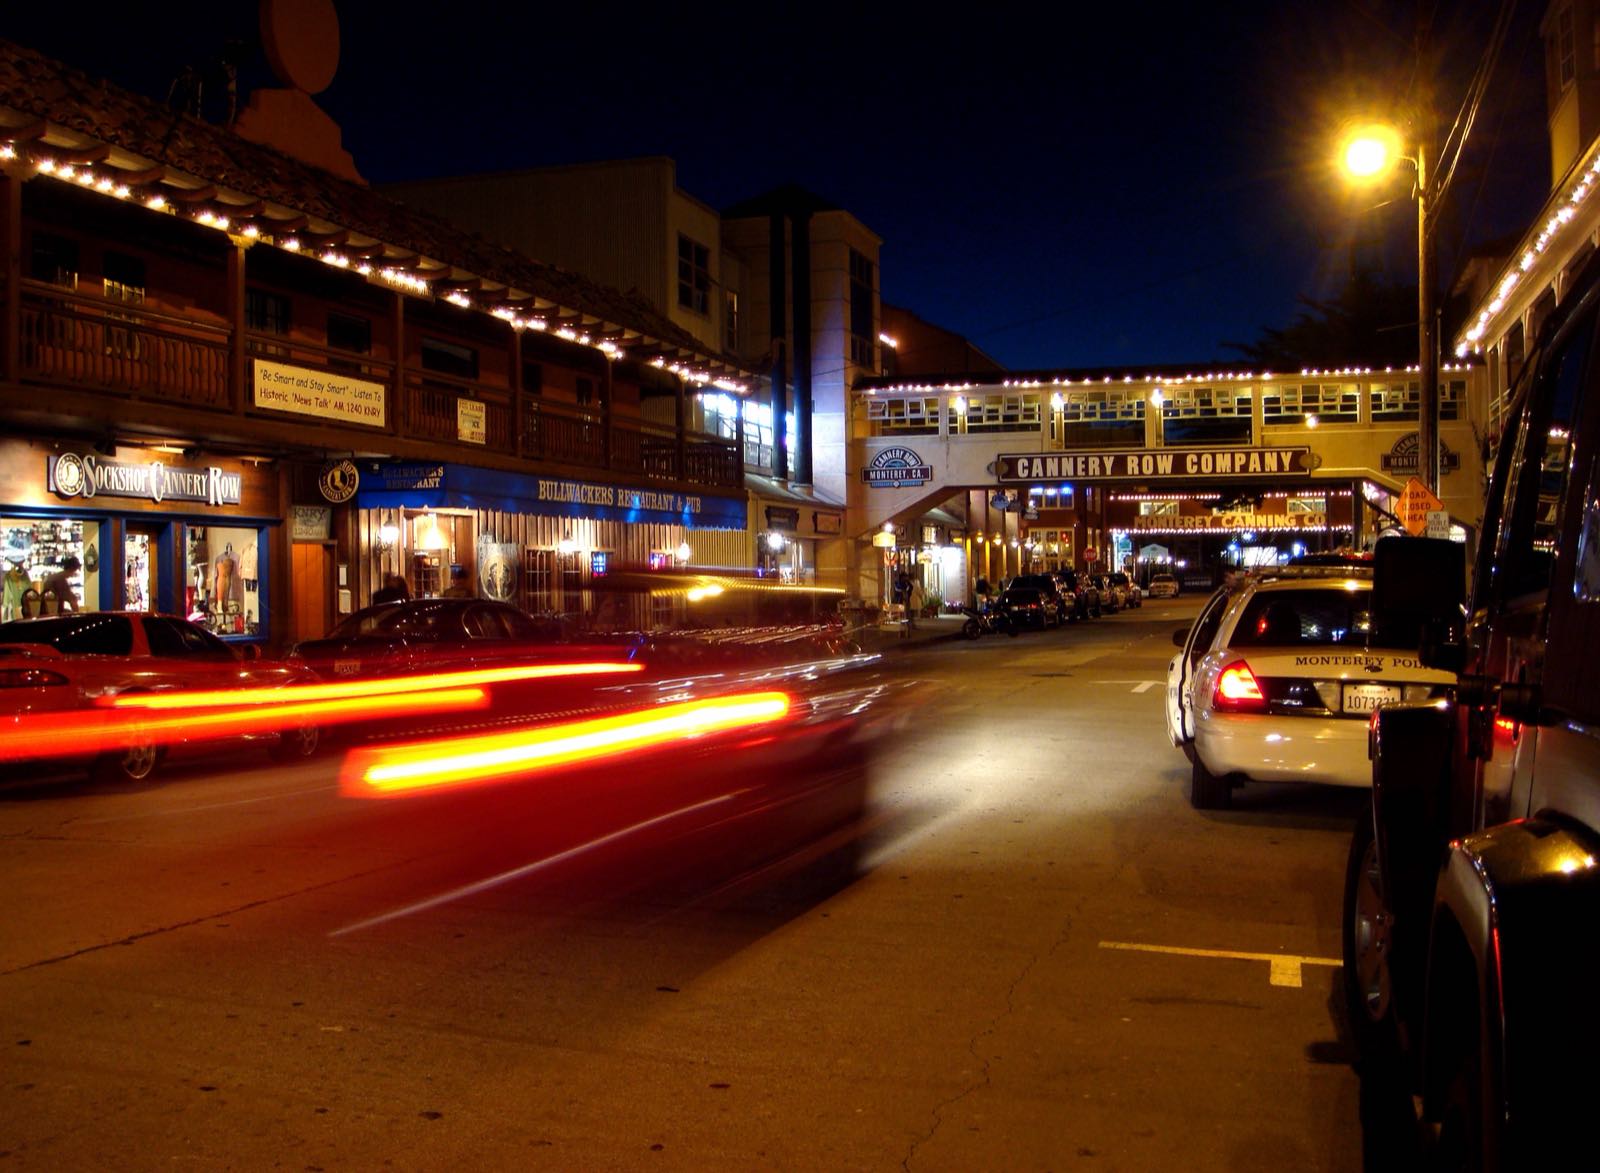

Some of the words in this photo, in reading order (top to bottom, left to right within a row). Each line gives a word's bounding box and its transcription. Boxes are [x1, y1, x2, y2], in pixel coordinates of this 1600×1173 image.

[274, 372, 295, 384] Smart
[296, 378, 308, 388] and
[309, 380, 324, 393] Stay
[354, 388, 373, 400] Listen
[374, 391, 382, 402] To
[260, 387, 288, 402] Historic
[334, 401, 344, 412] AM
[347, 403, 362, 415] 1240
[364, 406, 381, 418] KNRY
[875, 449, 903, 467] CANNERY
[903, 452, 918, 467] ROW
[1017, 455, 1114, 478] CANNERY
[1127, 453, 1173, 476] ROW
[1186, 451, 1293, 474] COMPANY
[83, 454, 148, 498] SOCKSHOP
[150, 460, 208, 501] CANNERY
[208, 466, 240, 505] ROW
[538, 480, 614, 507] BULLWACKERS
[617, 490, 674, 512] RESTAURANT
[676, 496, 682, 512] &
[686, 496, 701, 513] PUB
[1402, 503, 1431, 511] COSED
[1134, 515, 1213, 528] MONTEREY
[1221, 514, 1296, 528] CANNING
[1295, 656, 1384, 666] MONTEREY
[1393, 658, 1426, 669] POL
